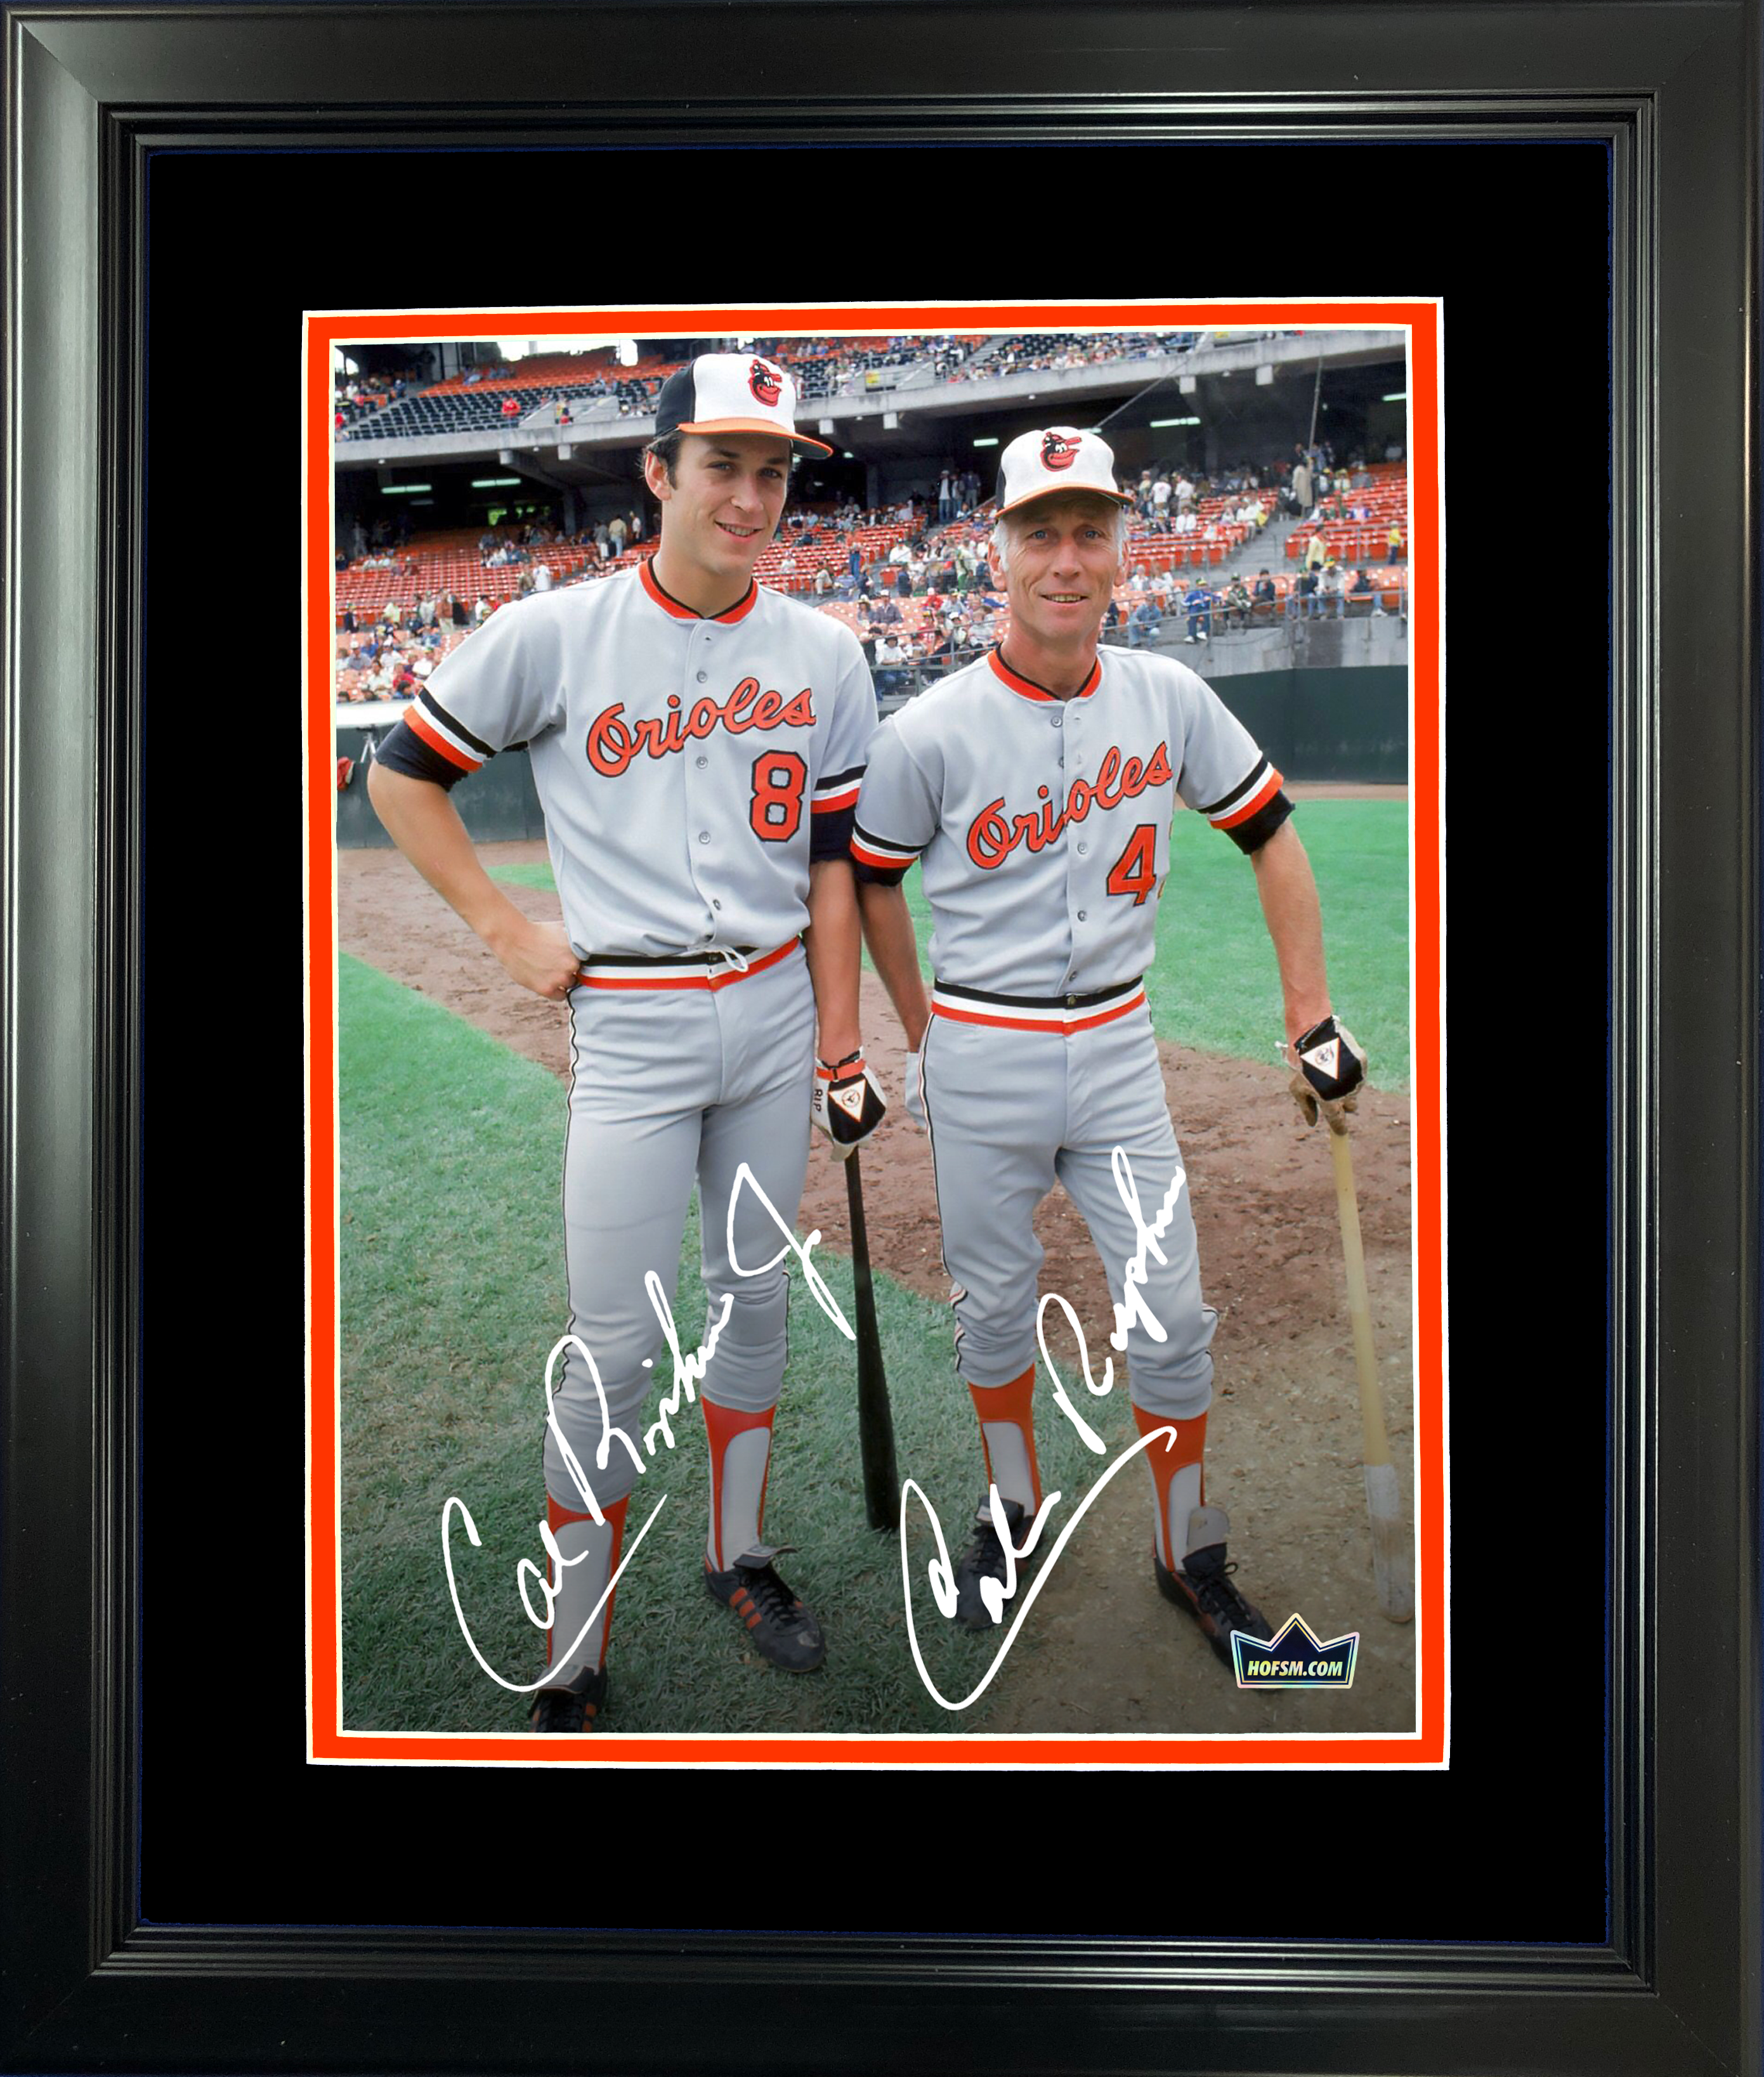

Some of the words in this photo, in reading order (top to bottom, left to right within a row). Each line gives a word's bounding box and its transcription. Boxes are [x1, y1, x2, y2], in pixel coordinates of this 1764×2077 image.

[586, 676, 816, 778] Orioles
[749, 750, 807, 842] 8
[966, 741, 1173, 869] Orioles
[1106, 821, 1173, 907] 4
[814, 1088, 823, 1112] RIP
